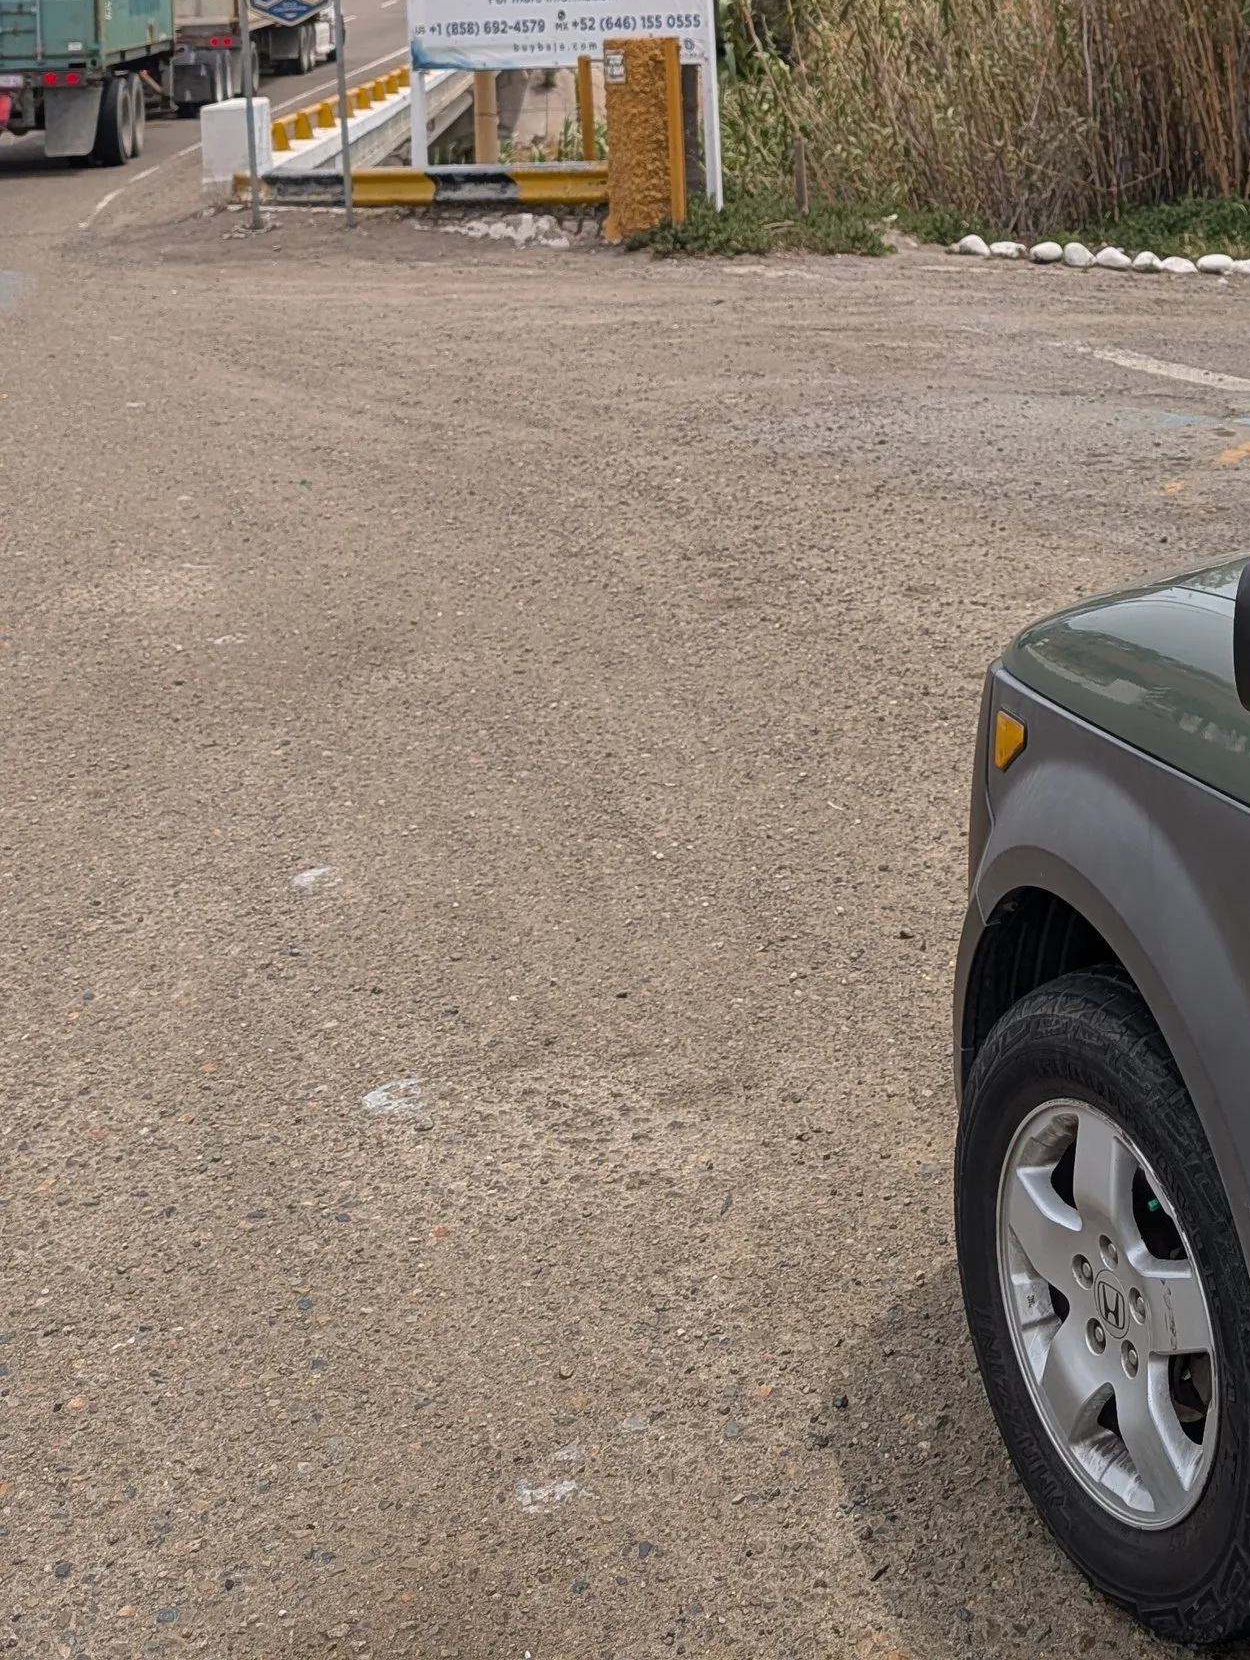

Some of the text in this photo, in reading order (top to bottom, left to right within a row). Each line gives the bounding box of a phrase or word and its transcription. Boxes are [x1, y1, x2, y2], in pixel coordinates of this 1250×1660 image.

[445, 20, 480, 38] (858)
[483, 18, 546, 36] 692-4579
[571, 16, 597, 32] +52
[599, 15, 638, 32] (646)
[641, 14, 663, 30] 155
[666, 13, 701, 29] 0555
